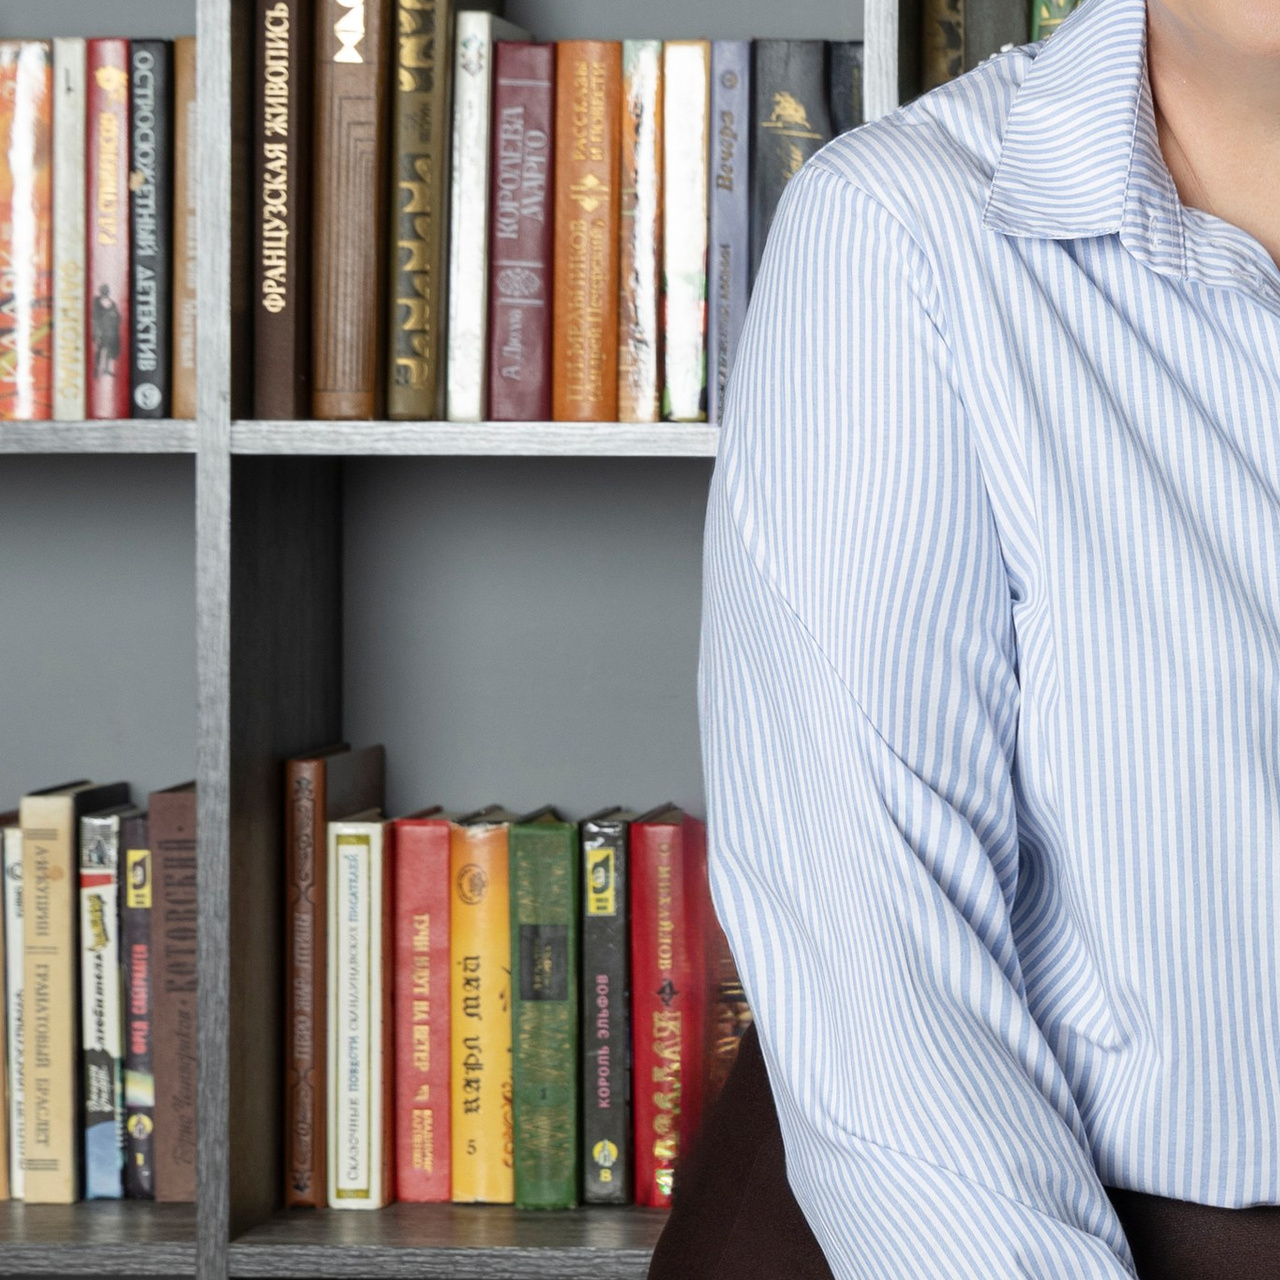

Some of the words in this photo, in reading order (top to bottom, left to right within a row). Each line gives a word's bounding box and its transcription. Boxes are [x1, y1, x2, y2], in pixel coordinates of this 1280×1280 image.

[264, 3, 289, 137] ЖИВОПИСЬ
[573, 61, 588, 161] РАССКАЗЫ
[591, 61, 606, 143] ПОВЕСТИ
[133, 50, 158, 256] ОСТРОСЮЖЕТНЫЙ
[497, 106, 526, 239] КОРОЛЕВА
[523, 129, 548, 221] МАРГО
[591, 149, 604, 161] И
[716, 111, 736, 192] Вечера
[263, 143, 289, 314] ФРАНЦУЗСКАЯ
[58, 261, 82, 400] ФАНТОМАС
[135, 264, 156, 371] ДЕТЕКТИВ
[158, 838, 196, 992] КОТОВСКИЙ
[412, 913, 429, 951] ТУЧИ
[658, 865, 675, 969] МИХАЙЛОВ
[35, 964, 51, 1068] ГРАНАТОВЫЙ
[412, 1000, 430, 1021] НА
[412, 1025, 430, 1071] ВЕТЕР
[594, 974, 610, 1039] ЭЛЬФОВ
[35, 1078, 50, 1146] БРАСЛЕТ
[596, 1045, 611, 1108] КОРОЛЬ
[466, 1139, 477, 1155] 5
